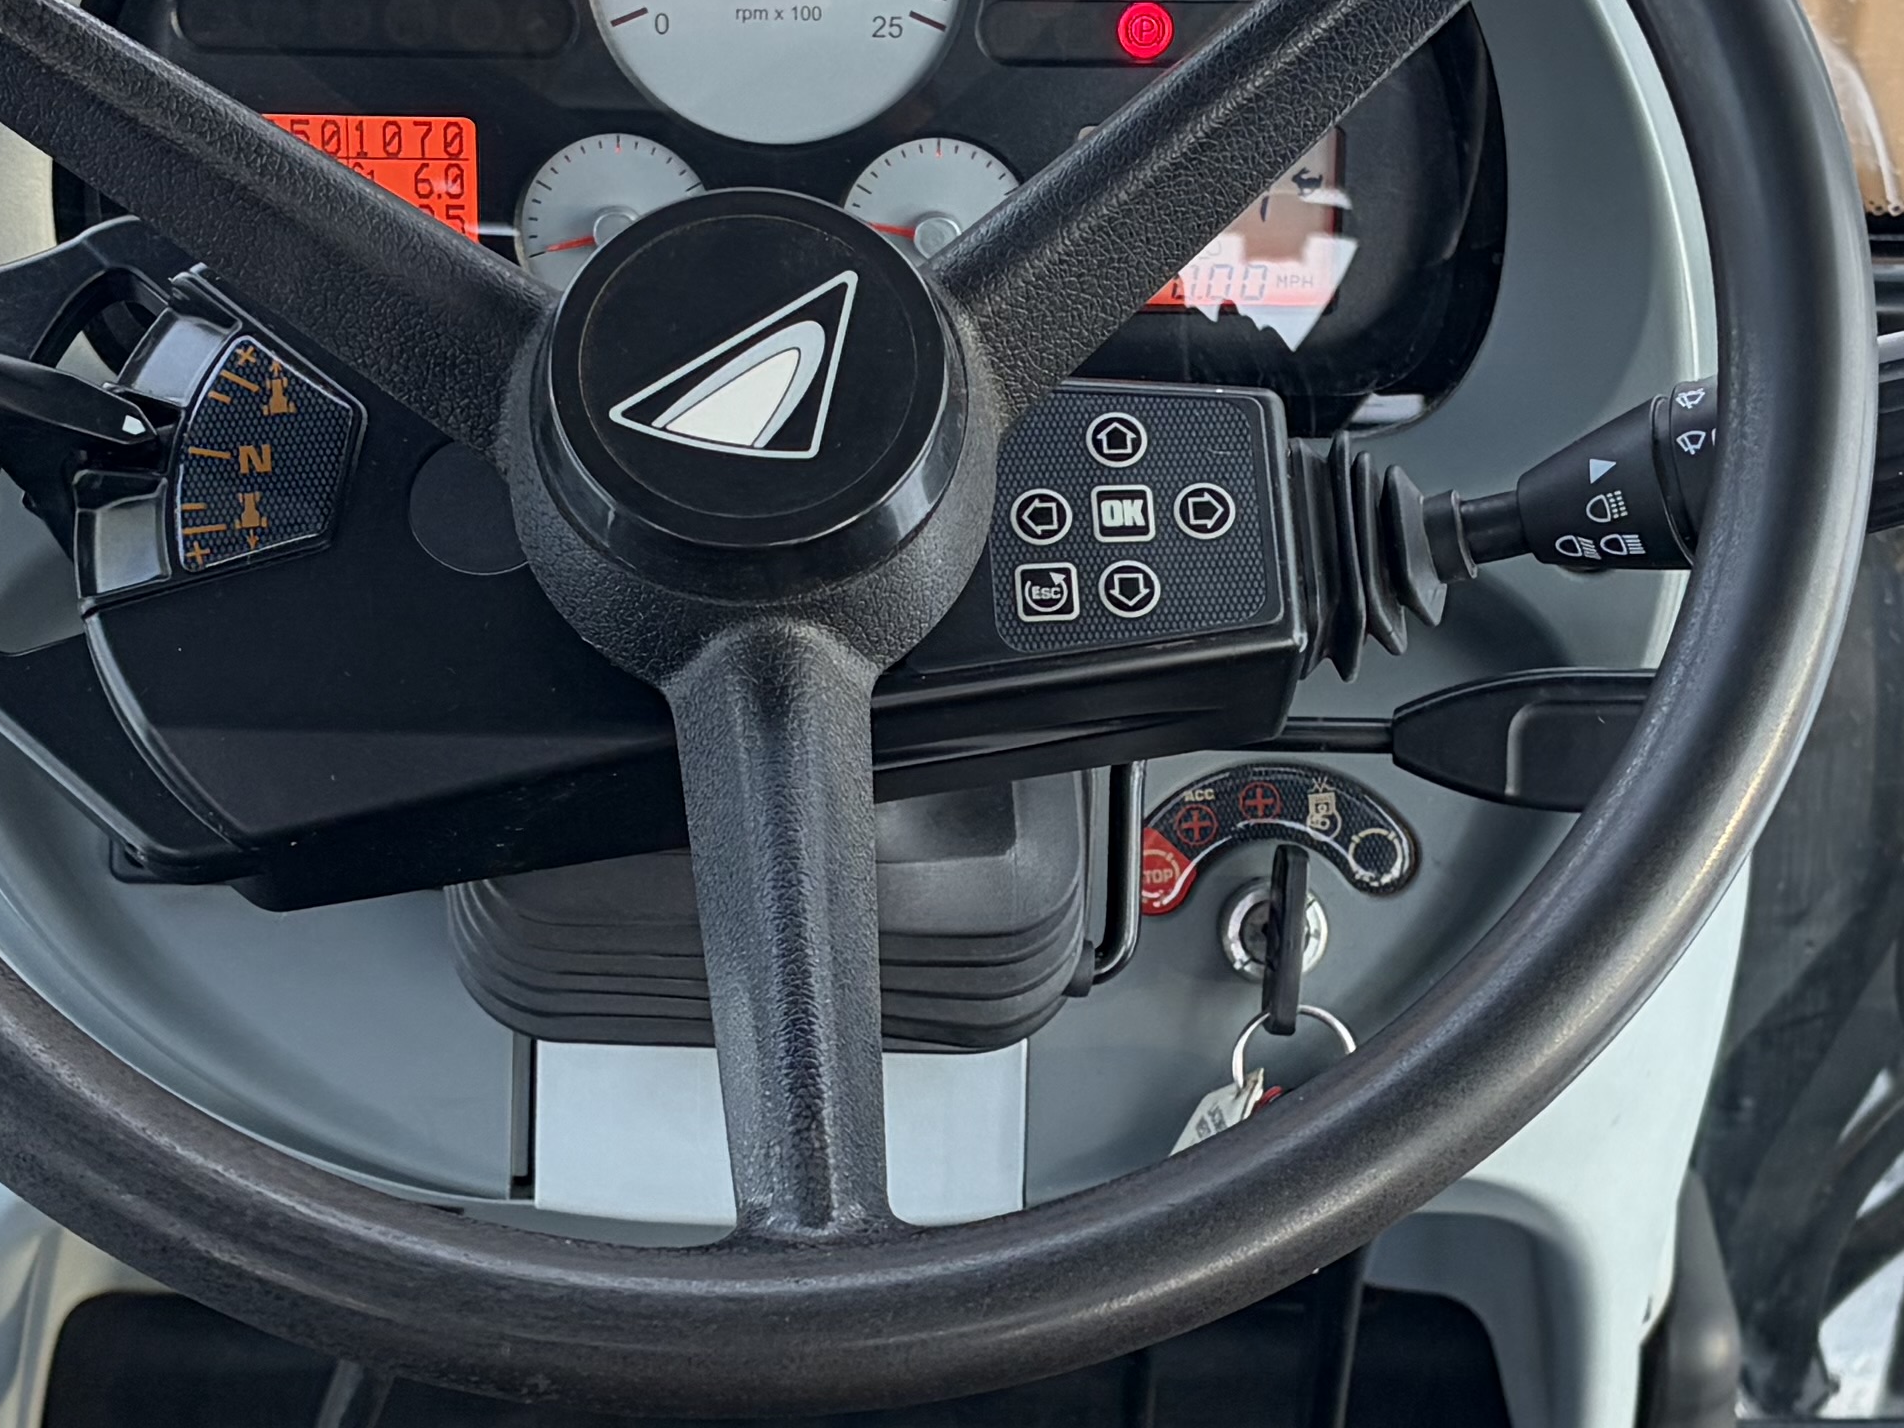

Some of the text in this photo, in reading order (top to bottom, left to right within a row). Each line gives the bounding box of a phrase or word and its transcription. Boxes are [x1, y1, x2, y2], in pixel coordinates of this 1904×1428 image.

[654, 13, 670, 36] 0
[735, 5, 822, 23] rpm x 100
[871, 15, 903, 39] 25
[414, 163, 464, 199] 6.0
[1276, 275, 1314, 290] MPH
[238, 444, 272, 474] N
[1100, 499, 1146, 528] OK
[1184, 788, 1215, 801] ACC
